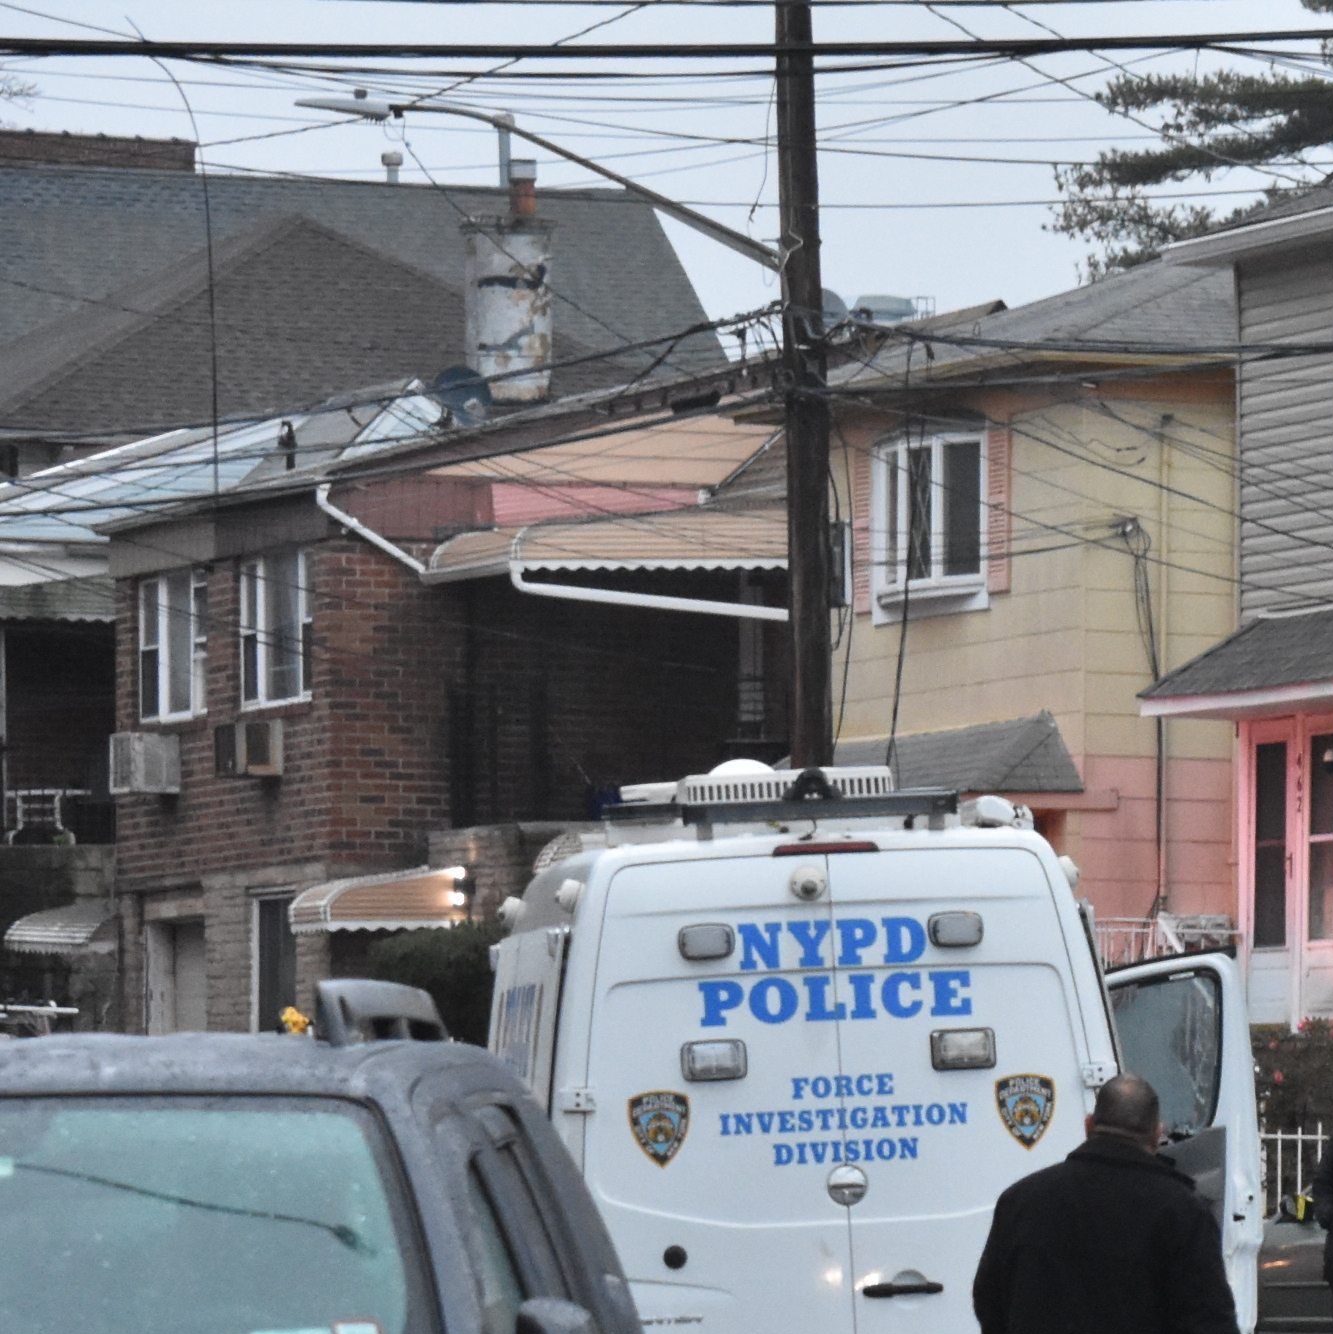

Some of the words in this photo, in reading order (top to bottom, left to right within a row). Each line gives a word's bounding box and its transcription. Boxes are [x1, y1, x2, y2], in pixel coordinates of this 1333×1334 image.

[737, 915, 928, 971] NYPD
[698, 970, 974, 1028] POLICE
[791, 1073, 895, 1100] FORCE
[719, 1101, 969, 1136] INVESTIGATION
[773, 1137, 919, 1165] DIVISION
